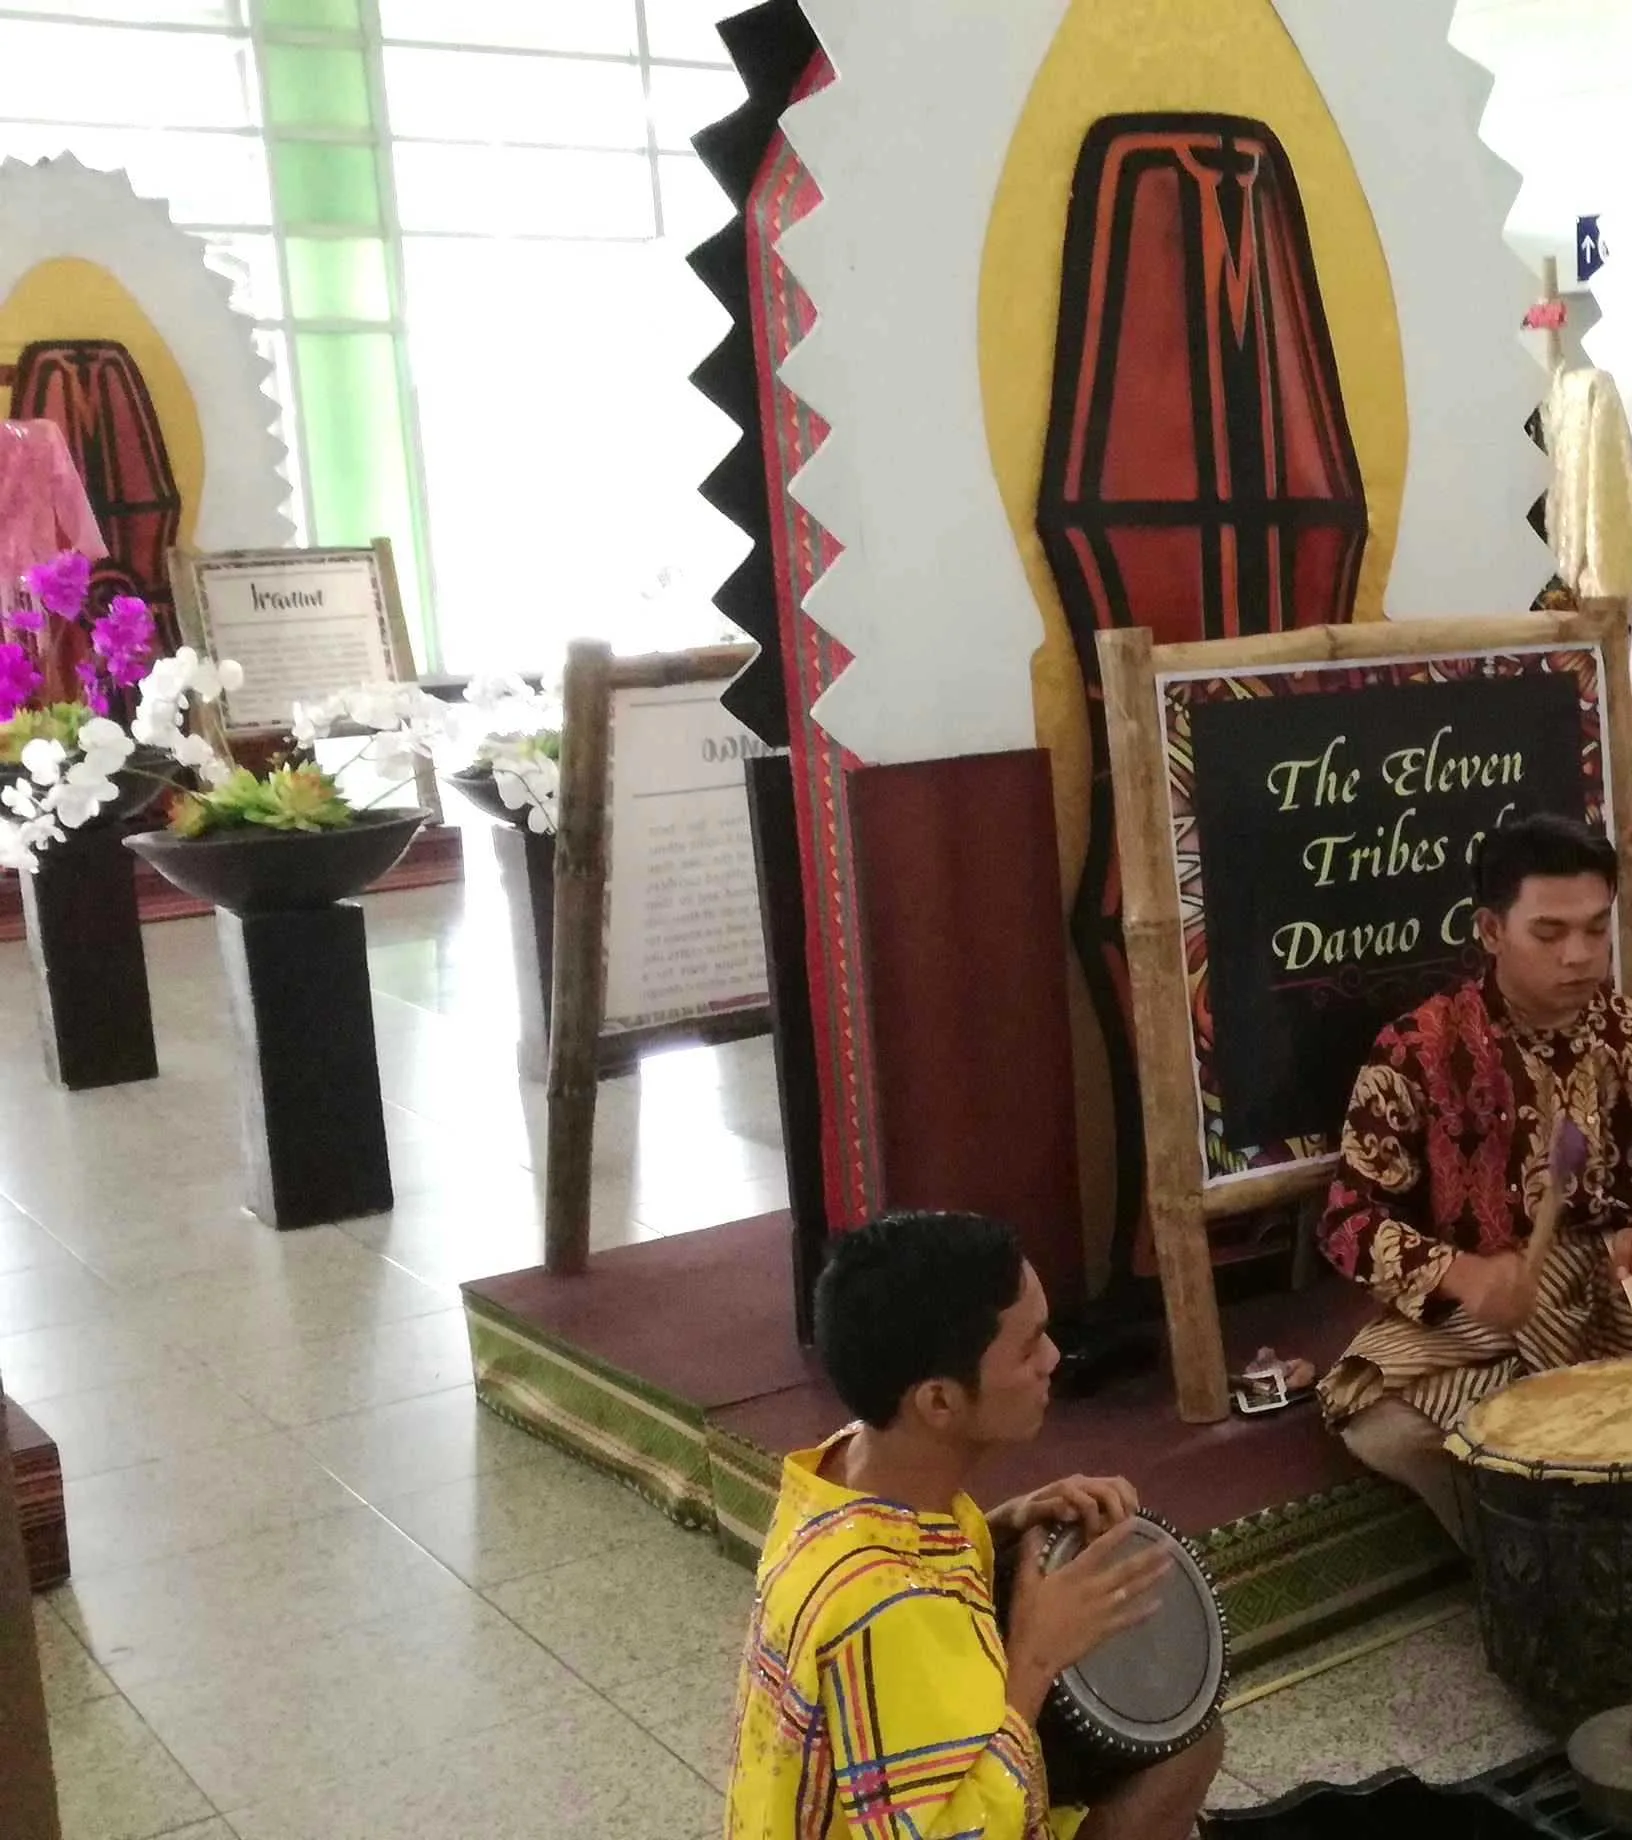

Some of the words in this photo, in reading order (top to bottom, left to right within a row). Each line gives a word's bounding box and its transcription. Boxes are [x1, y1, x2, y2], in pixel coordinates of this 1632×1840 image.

[1267, 734, 1360, 812] The
[1381, 725, 1525, 796] Eleven
[1302, 807, 1449, 887] Tribes
[1271, 917, 1421, 971] Davao
